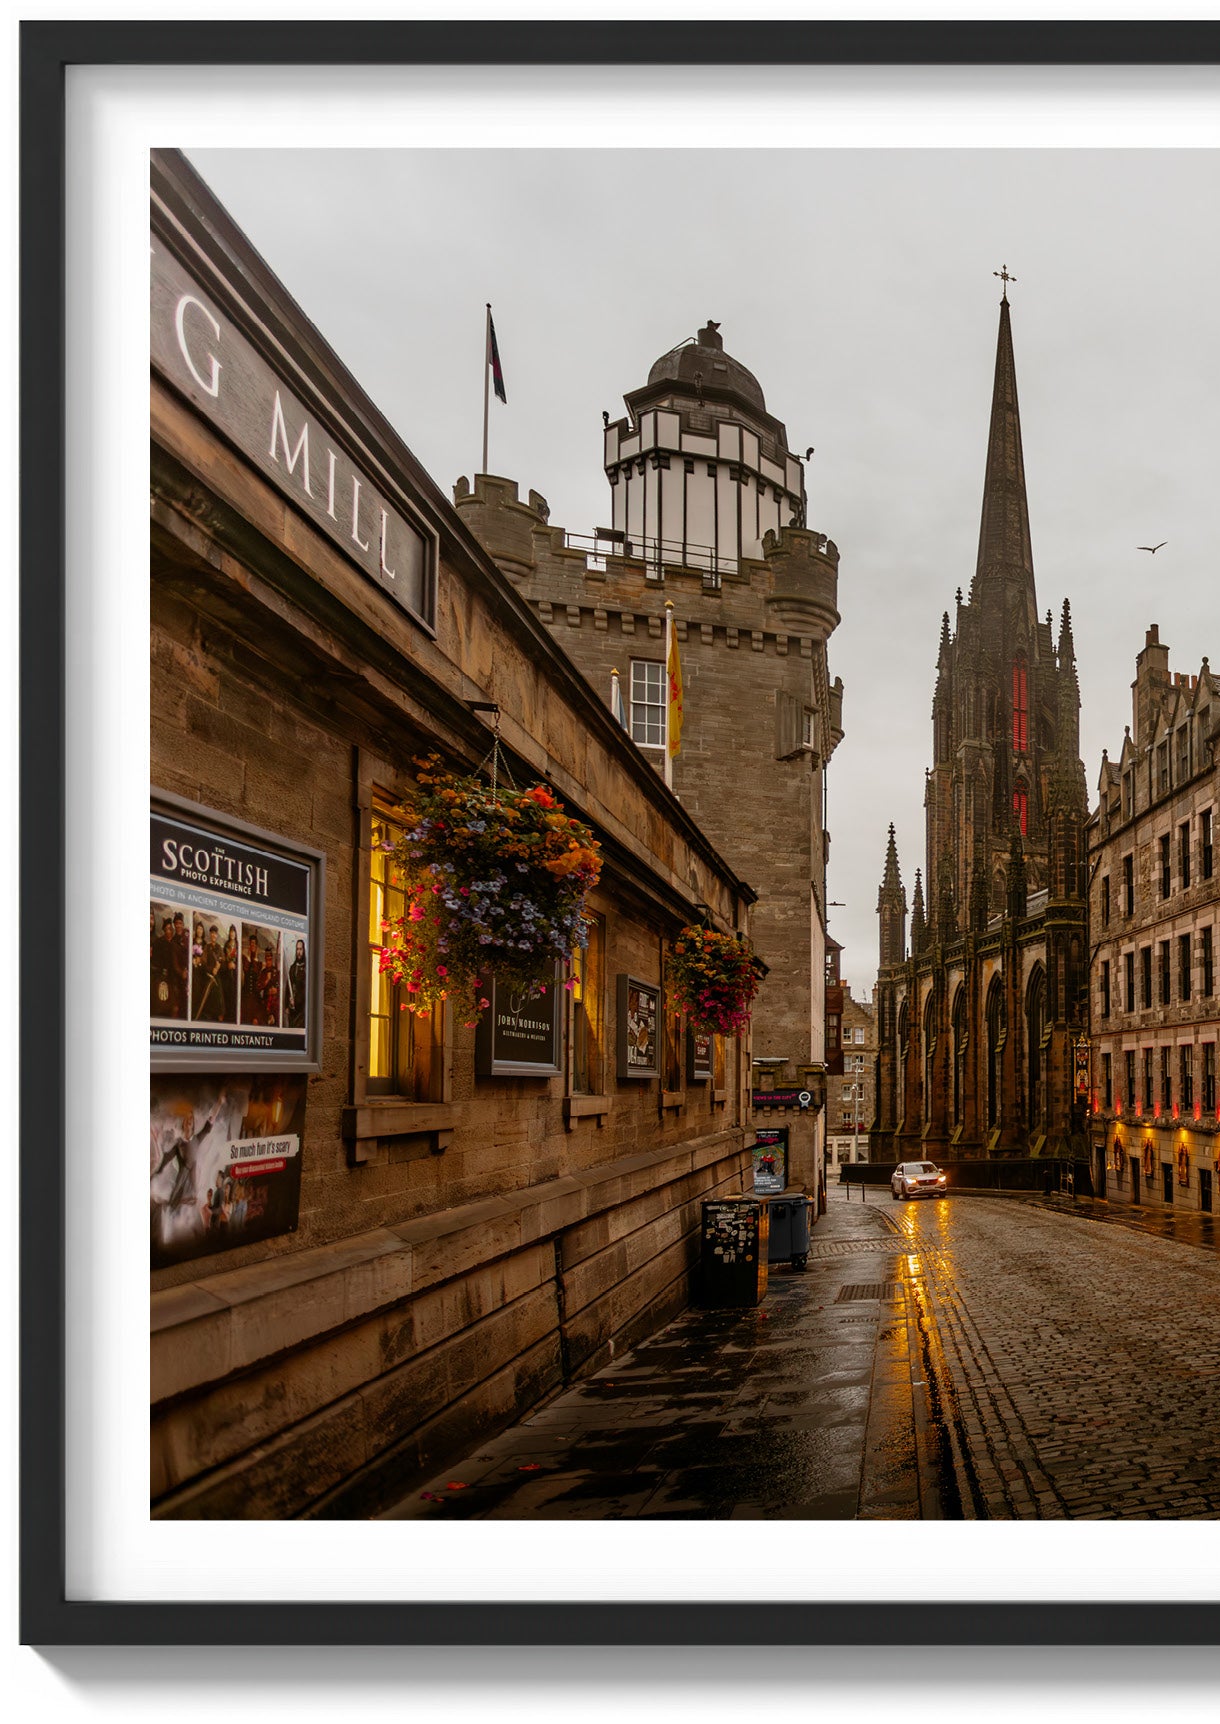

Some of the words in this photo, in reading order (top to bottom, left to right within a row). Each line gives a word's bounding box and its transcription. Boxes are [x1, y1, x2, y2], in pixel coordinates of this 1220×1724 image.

[268, 389, 396, 579] MILL
[161, 839, 270, 897] SCOTTISH
[180, 868, 208, 882] PHOTO
[209, 876, 253, 895] EXPERIENCE
[177, 890, 187, 900] IN
[187, 893, 218, 908] ANCIENT
[219, 901, 250, 915] SCOTTISH
[497, 1014, 516, 1026] JOHN
[518, 1018, 551, 1031] MORRISON
[189, 1031, 229, 1044] PRINTED
[231, 1034, 275, 1047] INSTANTLY
[230, 1144, 239, 1159] So
[239, 1142, 257, 1158] much
[256, 1141, 267, 1156] fun
[266, 1140, 276, 1154] it's
[275, 1141, 291, 1154] scary
